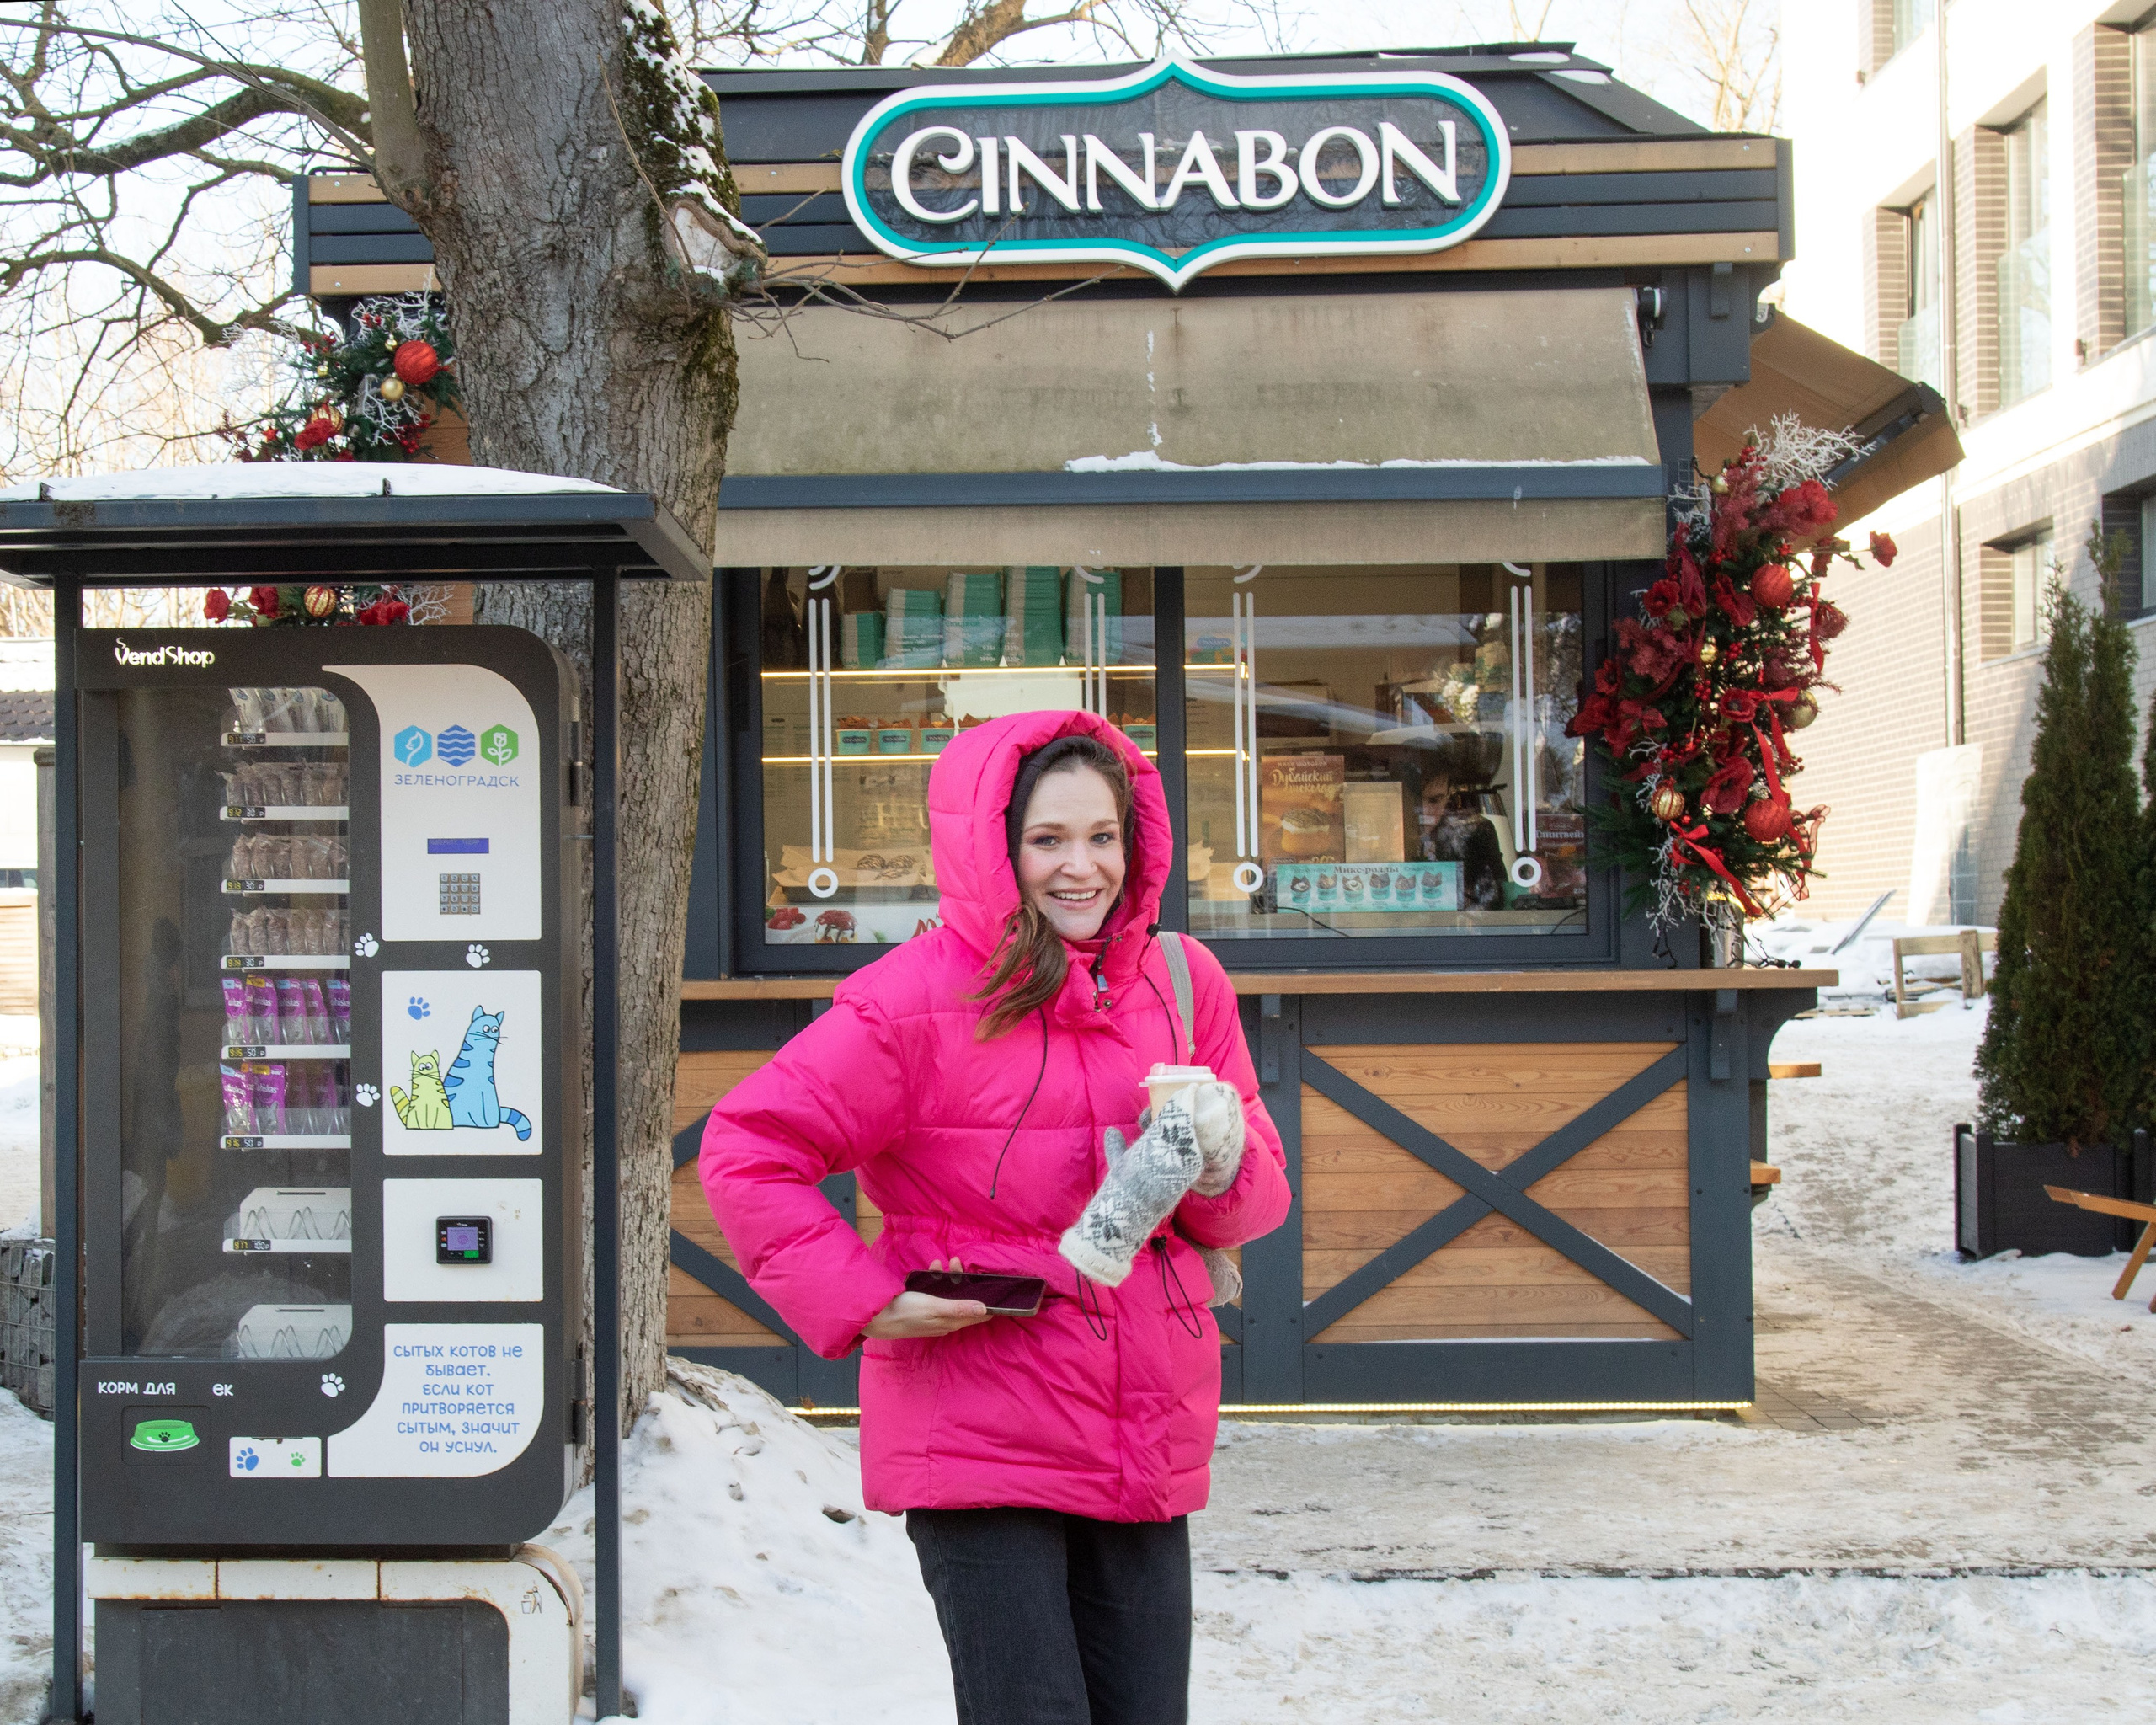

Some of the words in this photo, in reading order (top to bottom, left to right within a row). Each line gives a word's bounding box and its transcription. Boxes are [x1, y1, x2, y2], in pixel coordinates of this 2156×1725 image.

[890, 120, 1462, 223] CINNABON
[115, 644, 216, 668] VendShop
[393, 774, 520, 788] ЗЕЛЕНОГРАДСК
[393, 1345, 444, 1358] СЫТЫХ
[450, 1345, 497, 1358] КОТОВ
[98, 1381, 139, 1395] КОРМ
[142, 1382, 176, 1396] ДЛЯ
